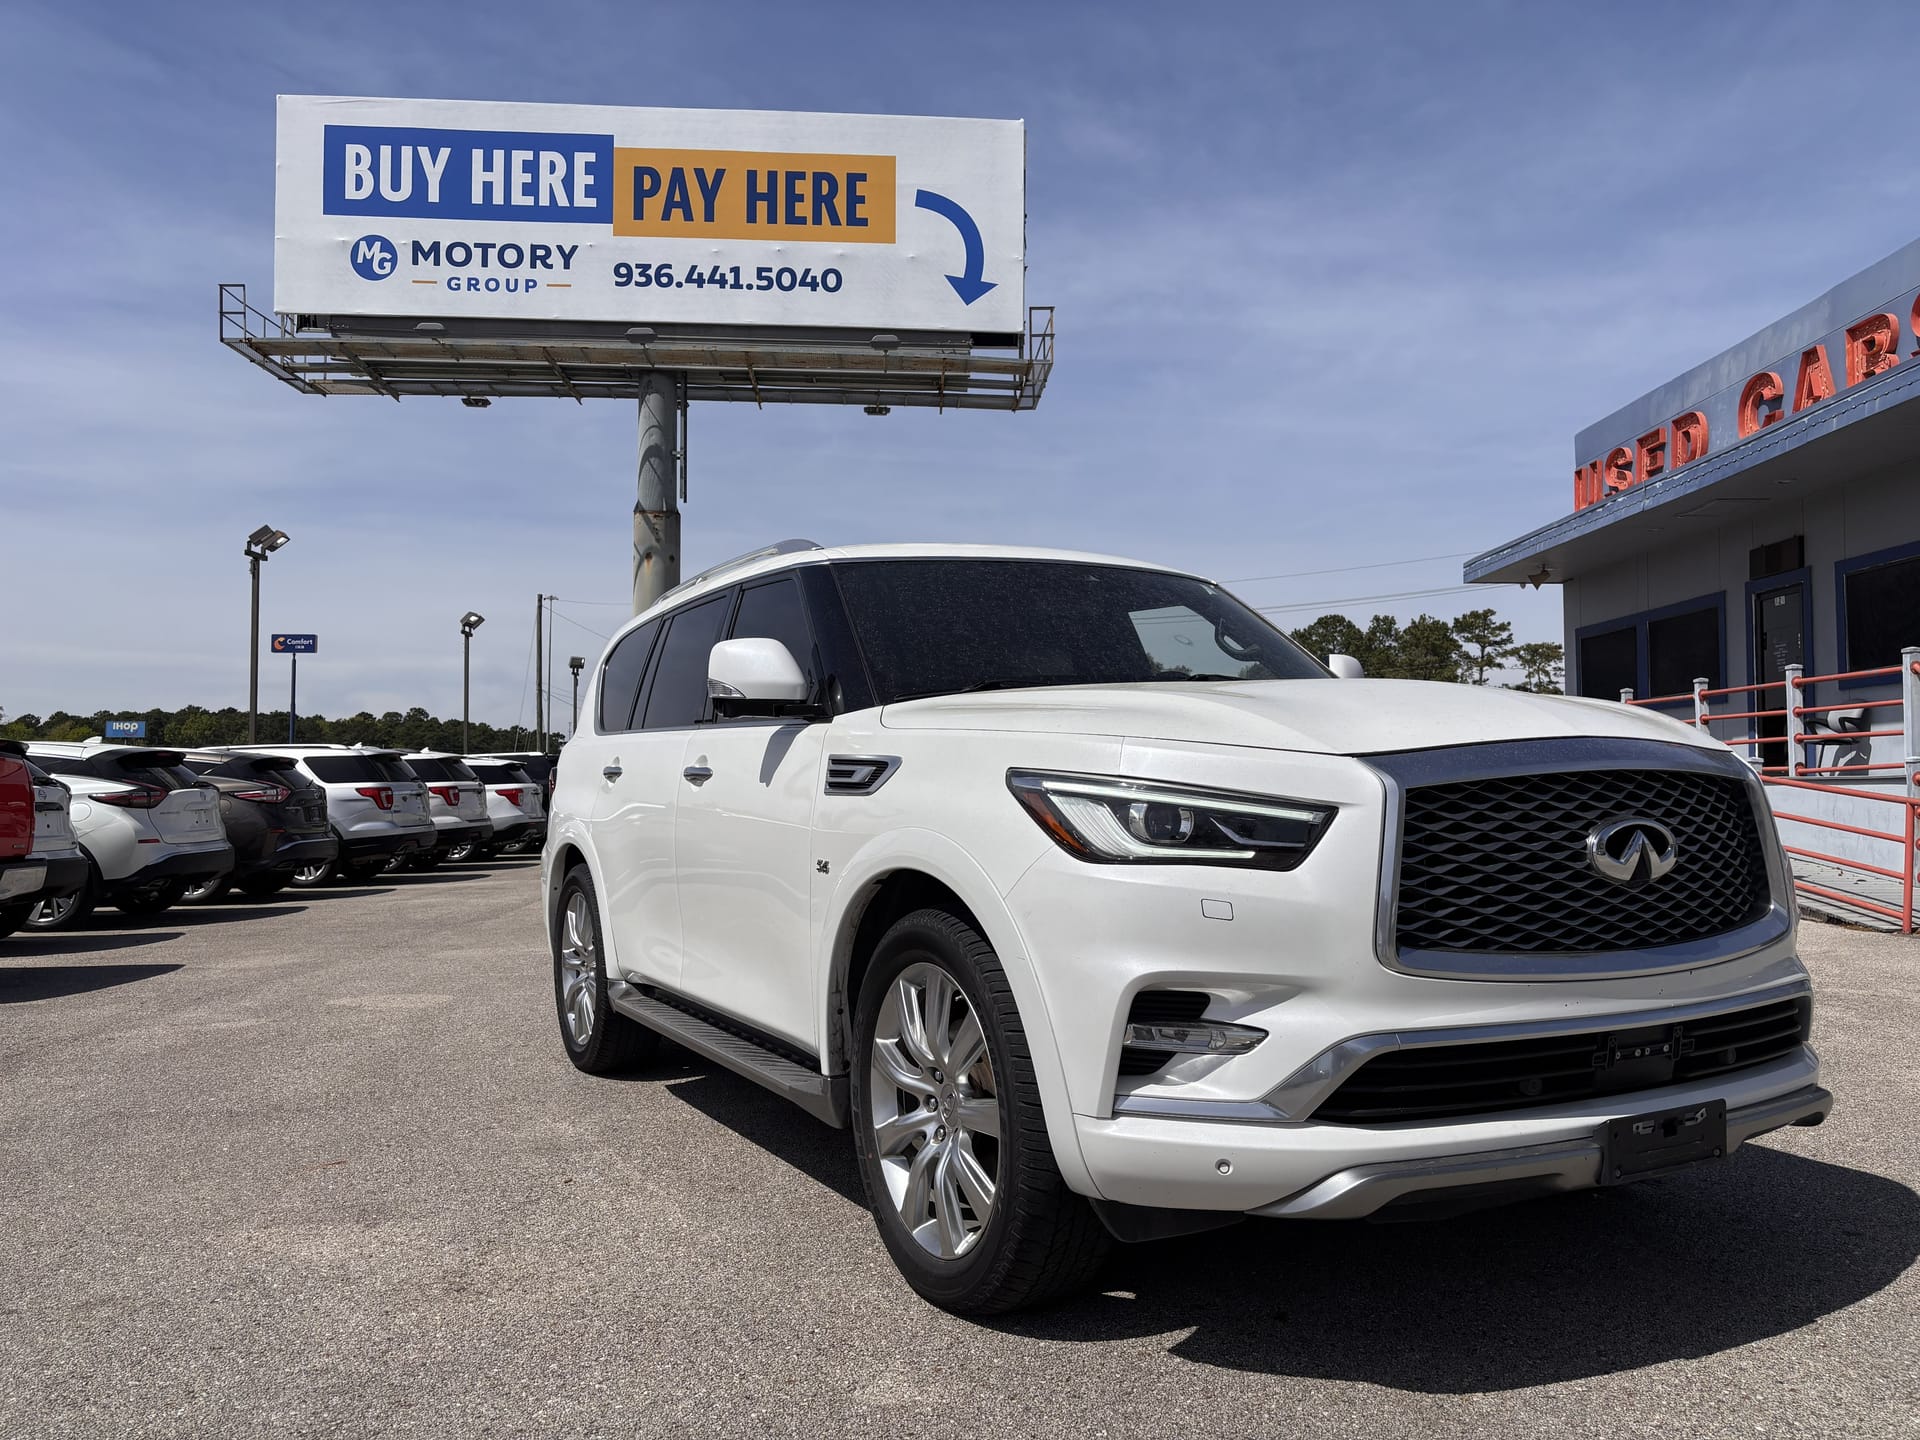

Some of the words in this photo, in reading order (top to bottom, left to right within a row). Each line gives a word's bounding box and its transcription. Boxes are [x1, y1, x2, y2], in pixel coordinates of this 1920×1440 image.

[344, 143, 452, 203] BUY
[471, 148, 597, 208] HERE
[632, 165, 727, 223] PAY
[745, 169, 869, 227] HERE
[356, 240, 393, 275] MG
[411, 240, 579, 270] MOTORY
[446, 276, 538, 293] GROUP
[612, 262, 843, 293] 936.441.5040
[1574, 411, 1709, 513] USED
[1737, 291, 1920, 440] CAR
